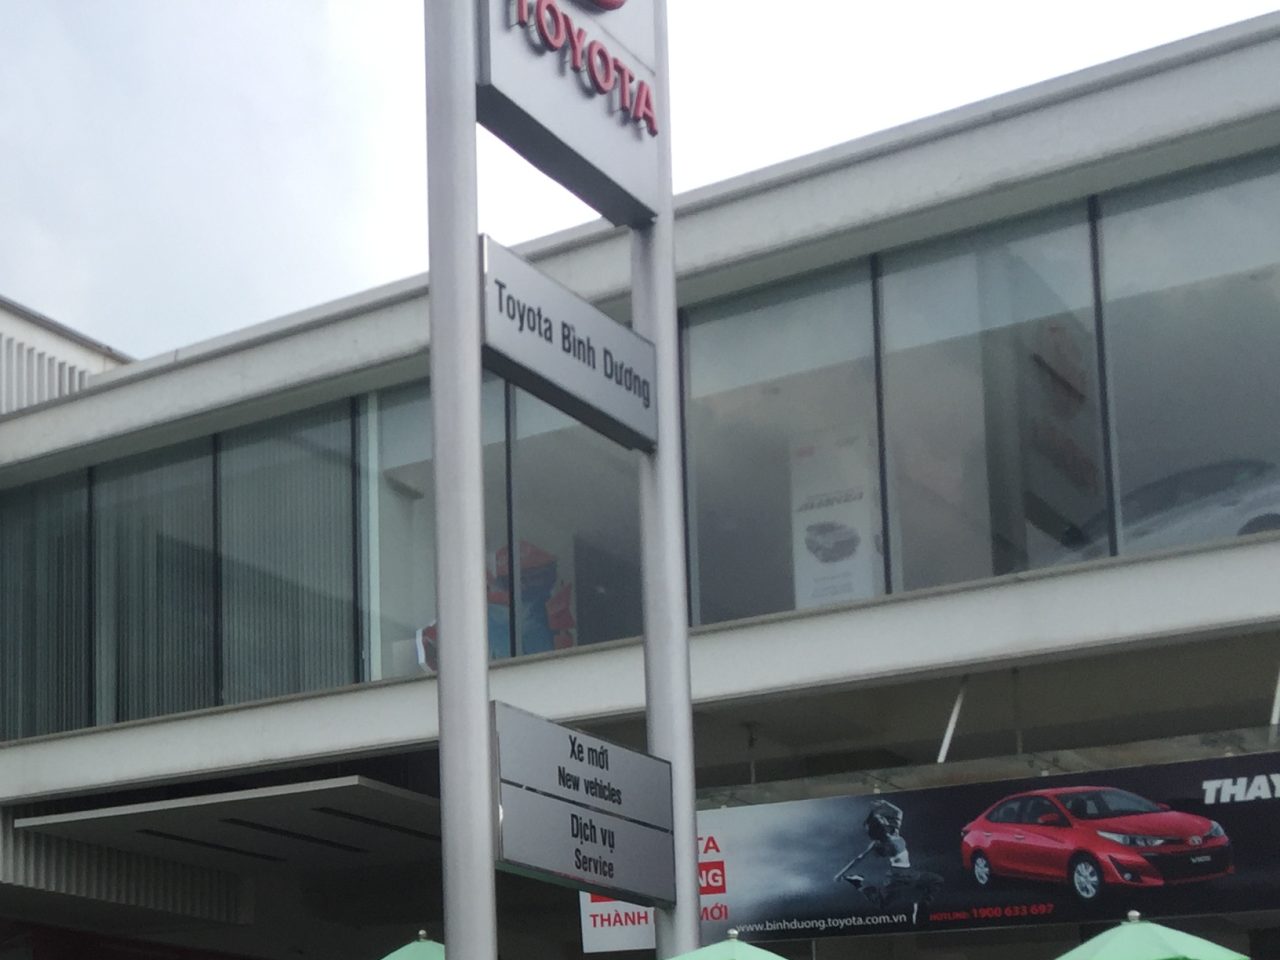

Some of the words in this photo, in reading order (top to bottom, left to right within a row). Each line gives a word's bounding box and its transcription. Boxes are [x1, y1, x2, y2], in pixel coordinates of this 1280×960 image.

[494, 278, 553, 344] Toyota
[569, 735, 584, 762] Xe
[558, 766, 579, 791] New
[584, 776, 622, 805] vehicles
[571, 813, 597, 844] Dịch
[600, 826, 615, 853] vụ
[574, 848, 614, 879] Service
[590, 909, 649, 928] THÀNH
[972, 906, 1002, 919] 1900
